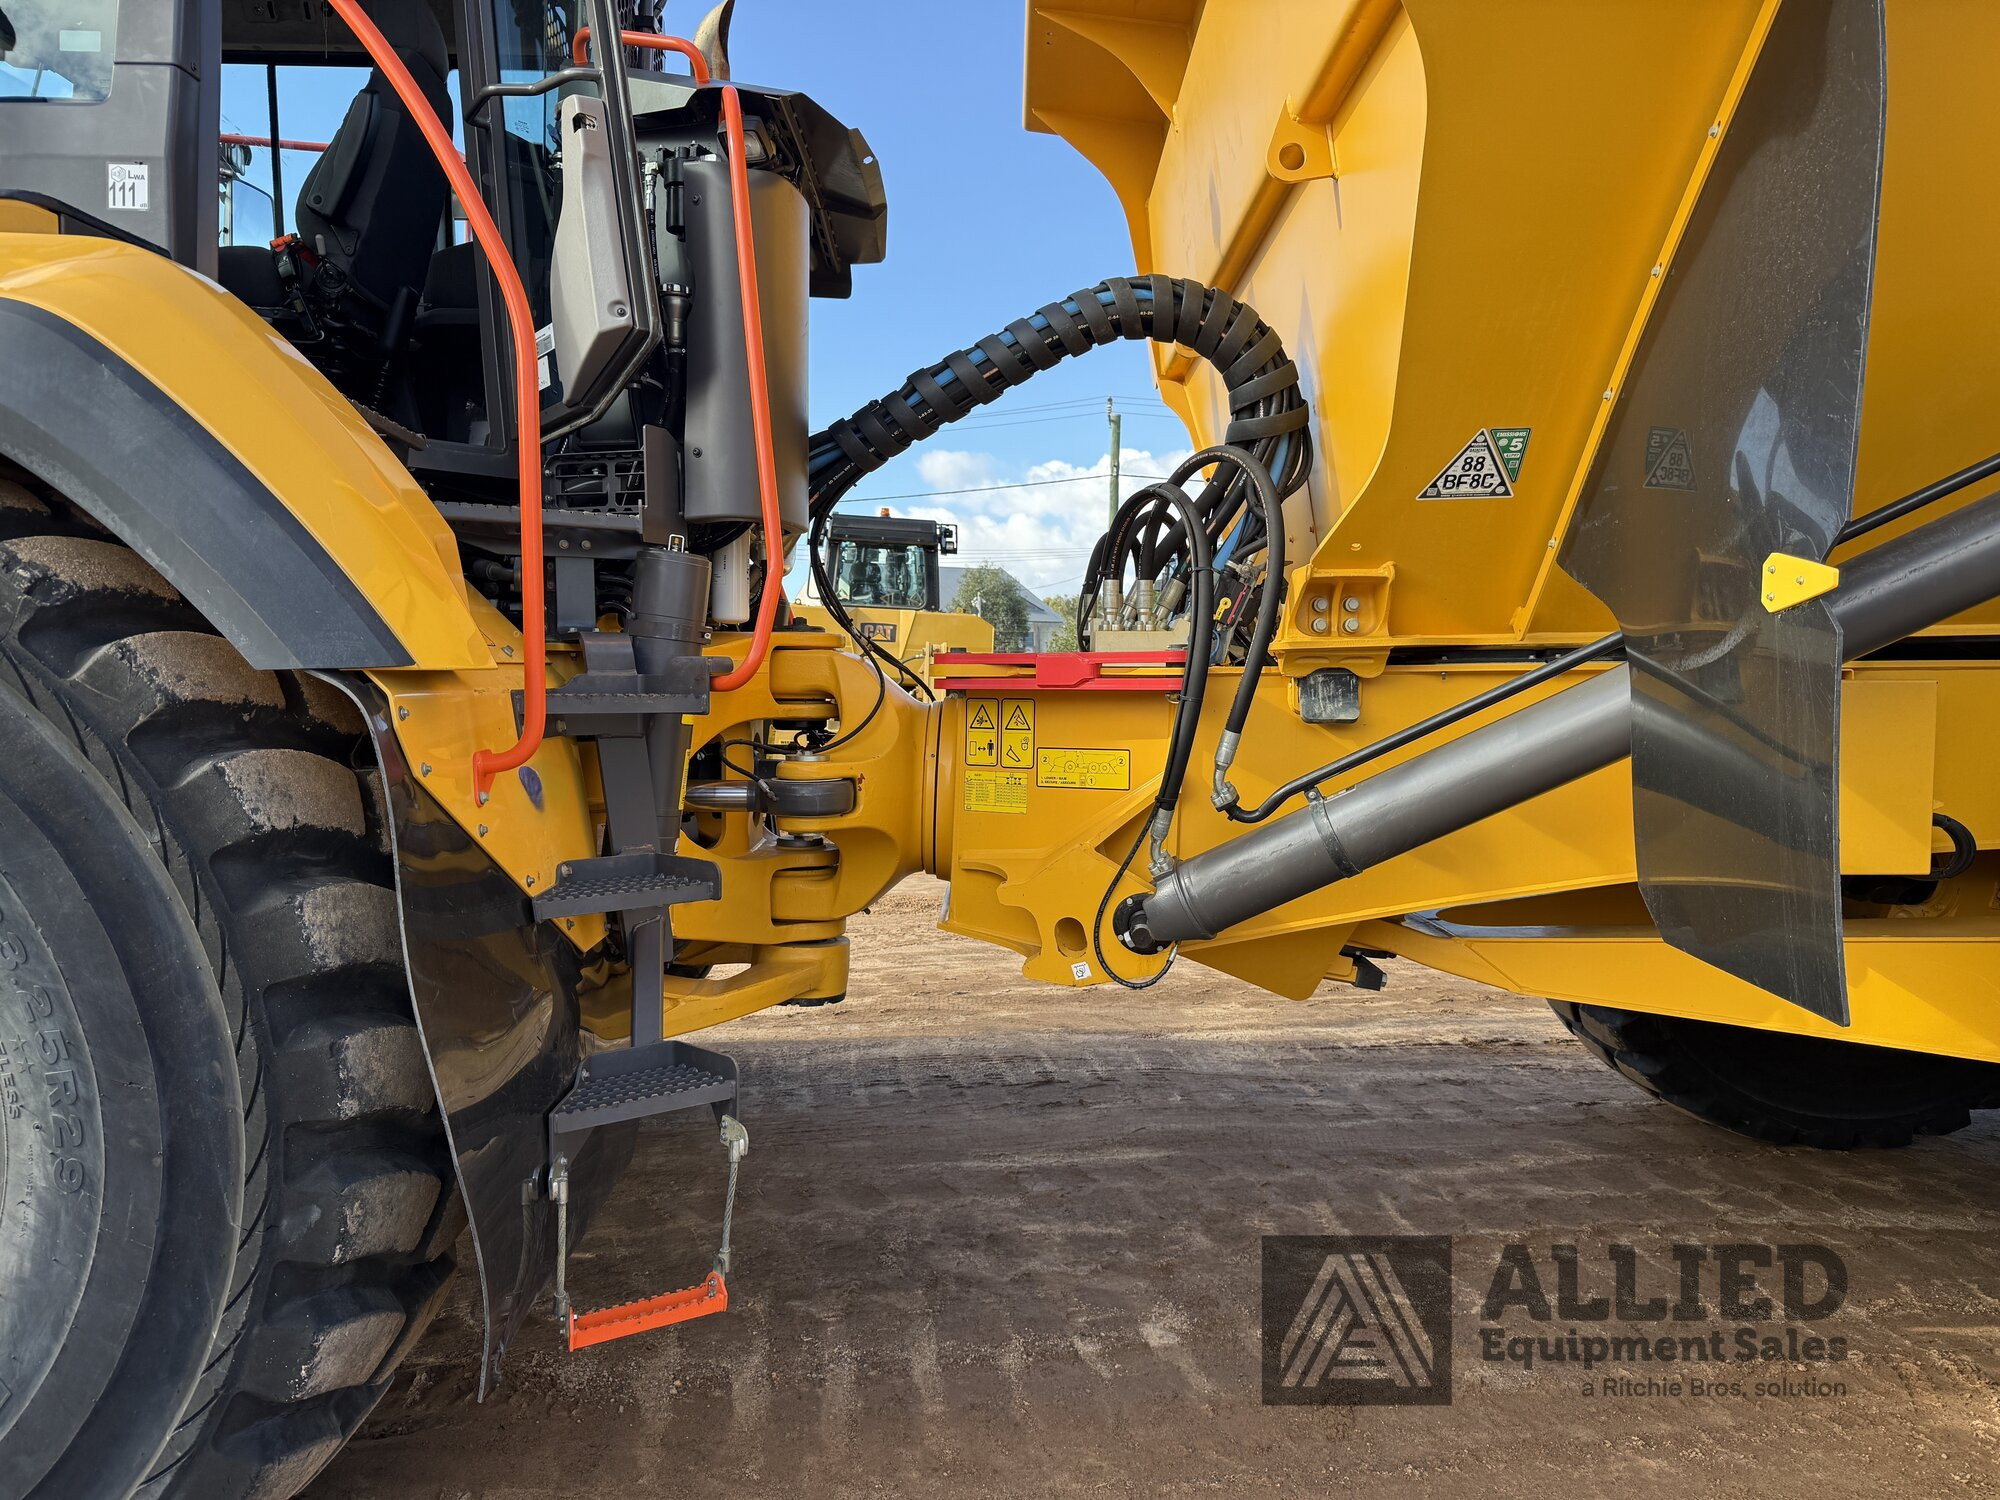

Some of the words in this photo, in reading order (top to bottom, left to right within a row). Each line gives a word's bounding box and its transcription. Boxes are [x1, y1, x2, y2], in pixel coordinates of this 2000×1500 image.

[109, 181, 136, 207] 111
[1508, 438, 1523, 451] 5
[1461, 456, 1487, 472] 88
[1442, 473, 1495, 490] BF8C
[864, 624, 894, 641] CAT
[0, 906, 85, 1194] 3.25R29
